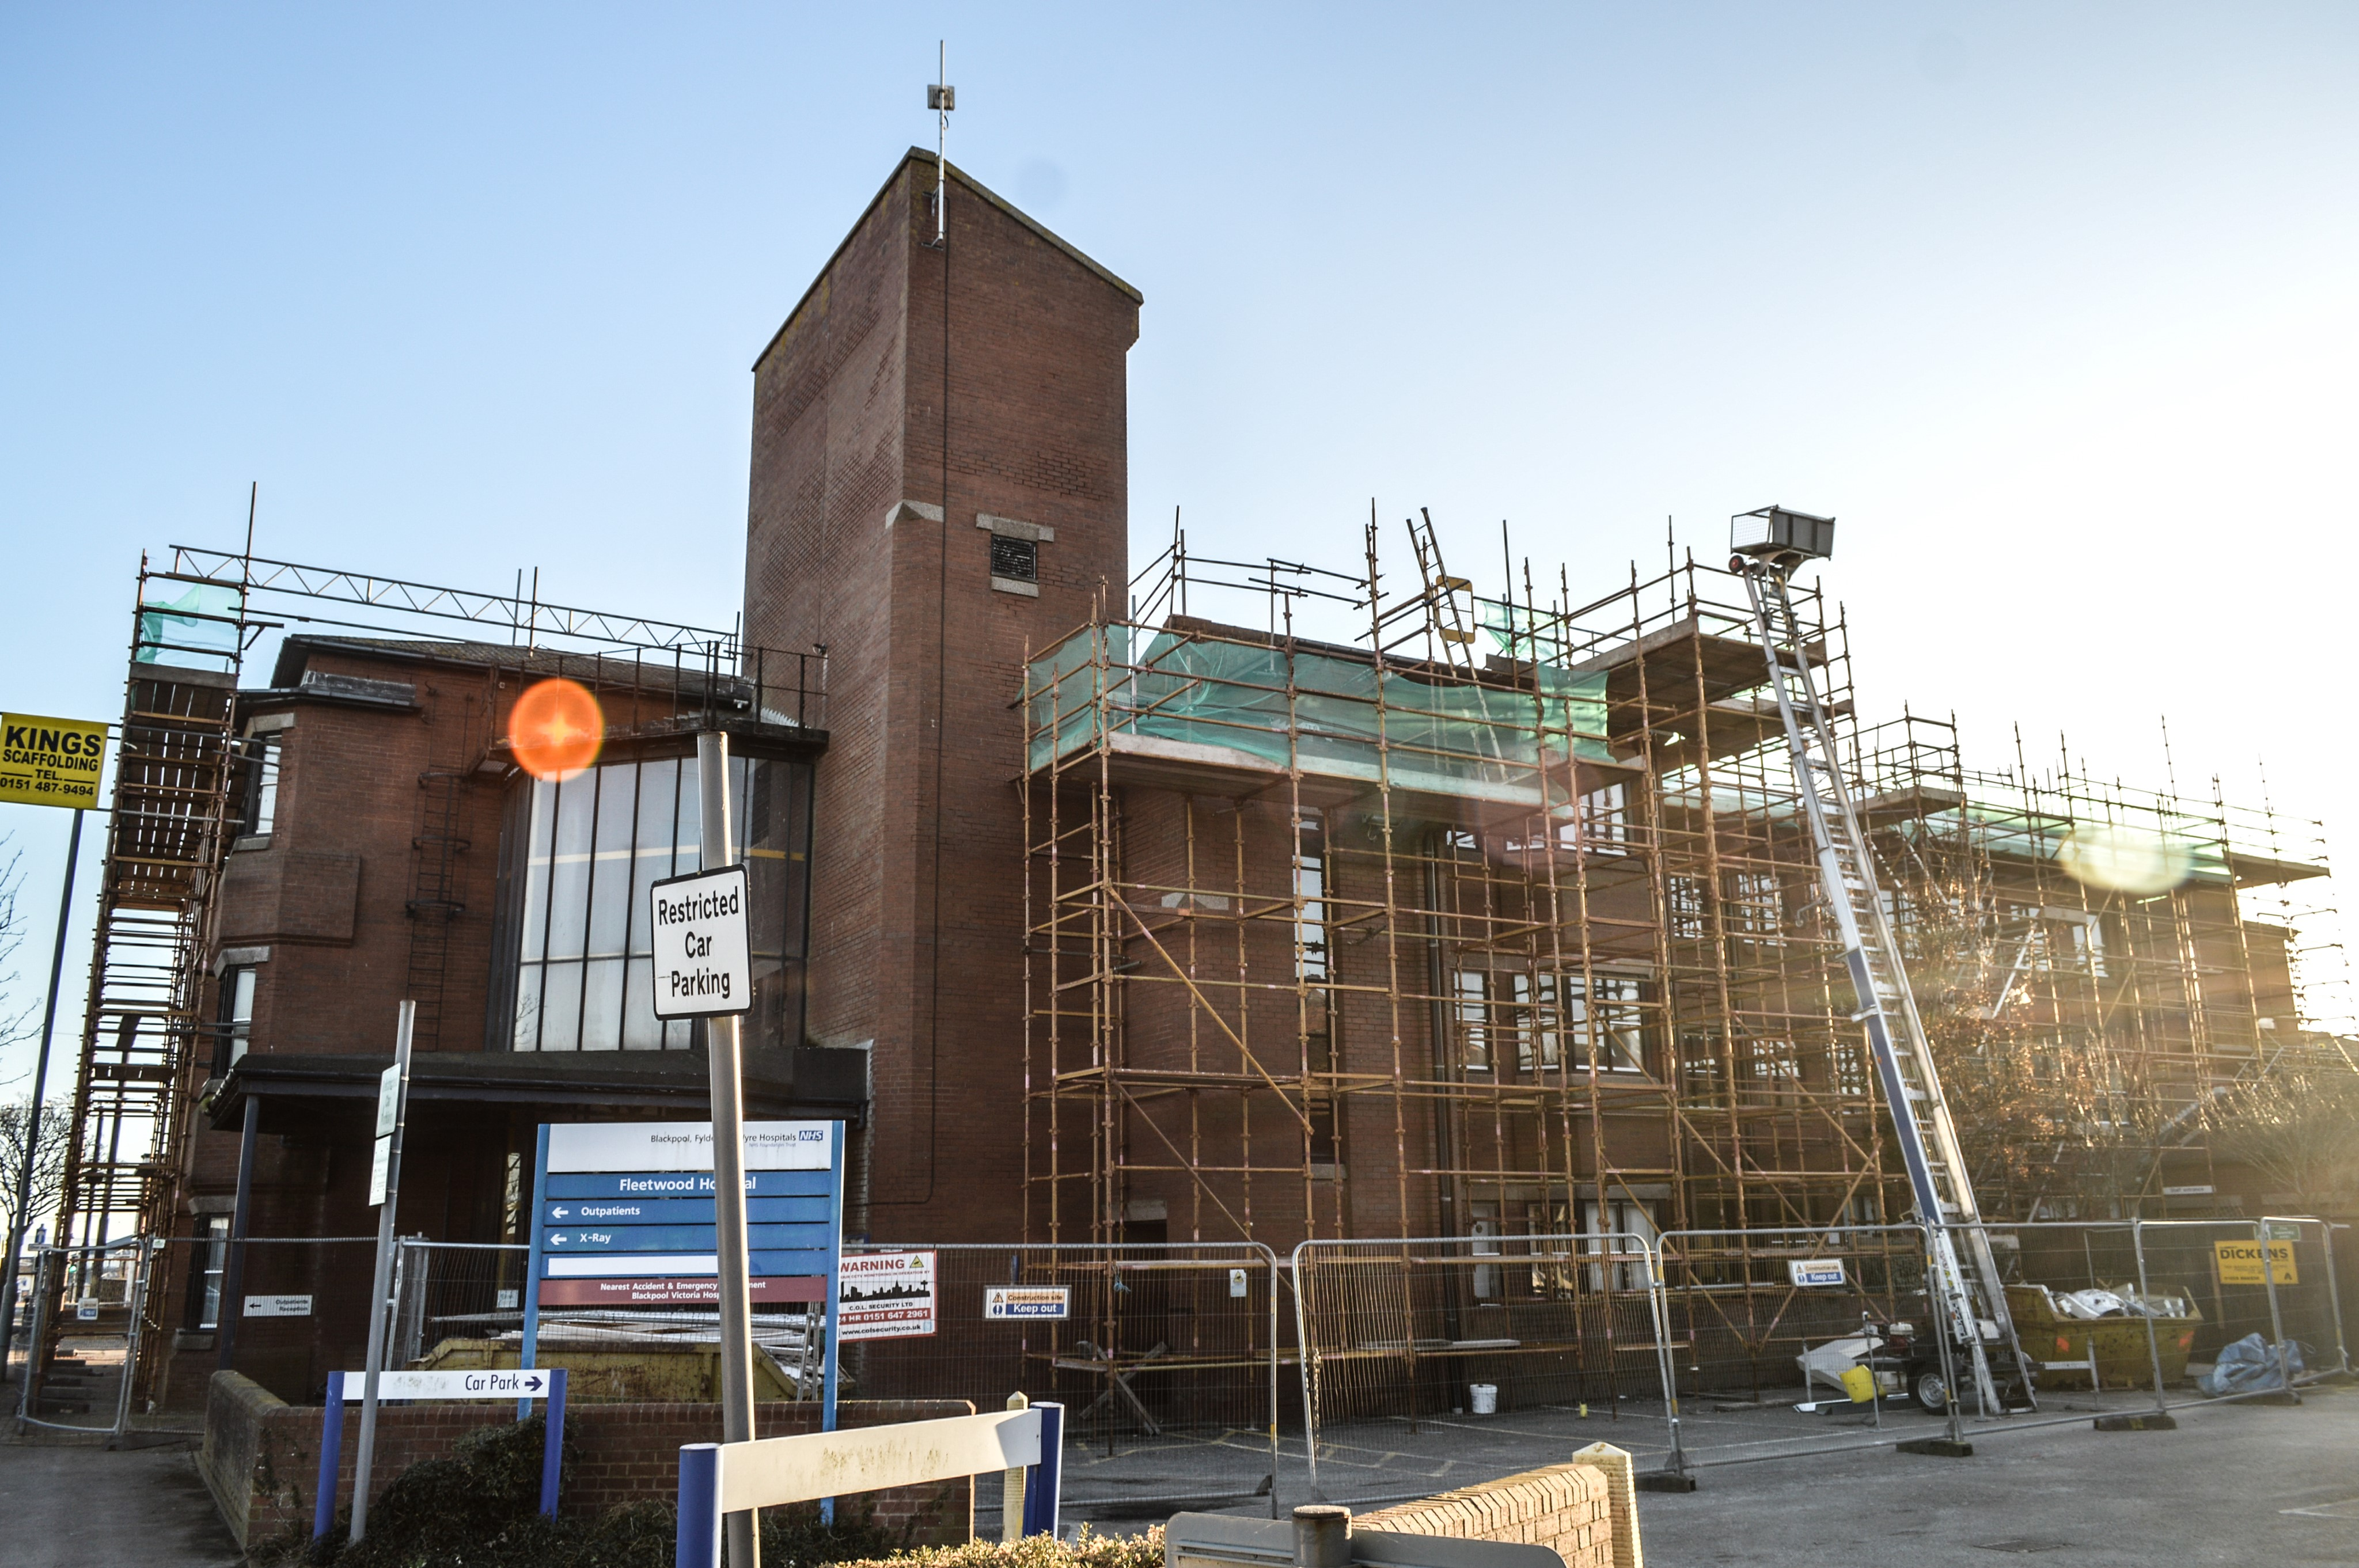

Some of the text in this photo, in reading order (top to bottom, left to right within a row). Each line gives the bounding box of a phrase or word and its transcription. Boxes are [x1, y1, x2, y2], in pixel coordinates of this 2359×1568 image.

[5, 725, 101, 757] KINGS
[2, 749, 98, 772] SCAFFOLDING
[35, 769, 63, 781] TEL.
[0, 777, 94, 796] 0151 487-9494
[658, 886, 739, 925] Restricted
[685, 931, 712, 958] Car
[672, 967, 730, 999] Parking
[651, 1134, 692, 1144] Blackpool,
[742, 1134, 757, 1143] yre
[759, 1133, 797, 1142] Hospitals
[799, 1131, 822, 1140] NHS
[619, 1178, 694, 1191] Fleetwood
[581, 1206, 640, 1217] Outpatients
[580, 1233, 611, 1244] X-Ray
[2220, 1248, 2289, 1259] DICKENS
[1811, 1273, 1827, 1281] Keep
[676, 1282, 717, 1291] Emergency
[632, 1291, 668, 1300] Blackpool
[671, 1290, 700, 1299] Victoria
[863, 1313, 885, 1321] 0151
[888, 1311, 904, 1319] 647
[907, 1309, 928, 1318] 2961
[1014, 1304, 1057, 1314] Keep out
[841, 1324, 921, 1335] www.colsecurity.co.uk
[465, 1373, 519, 1391] Car Park
